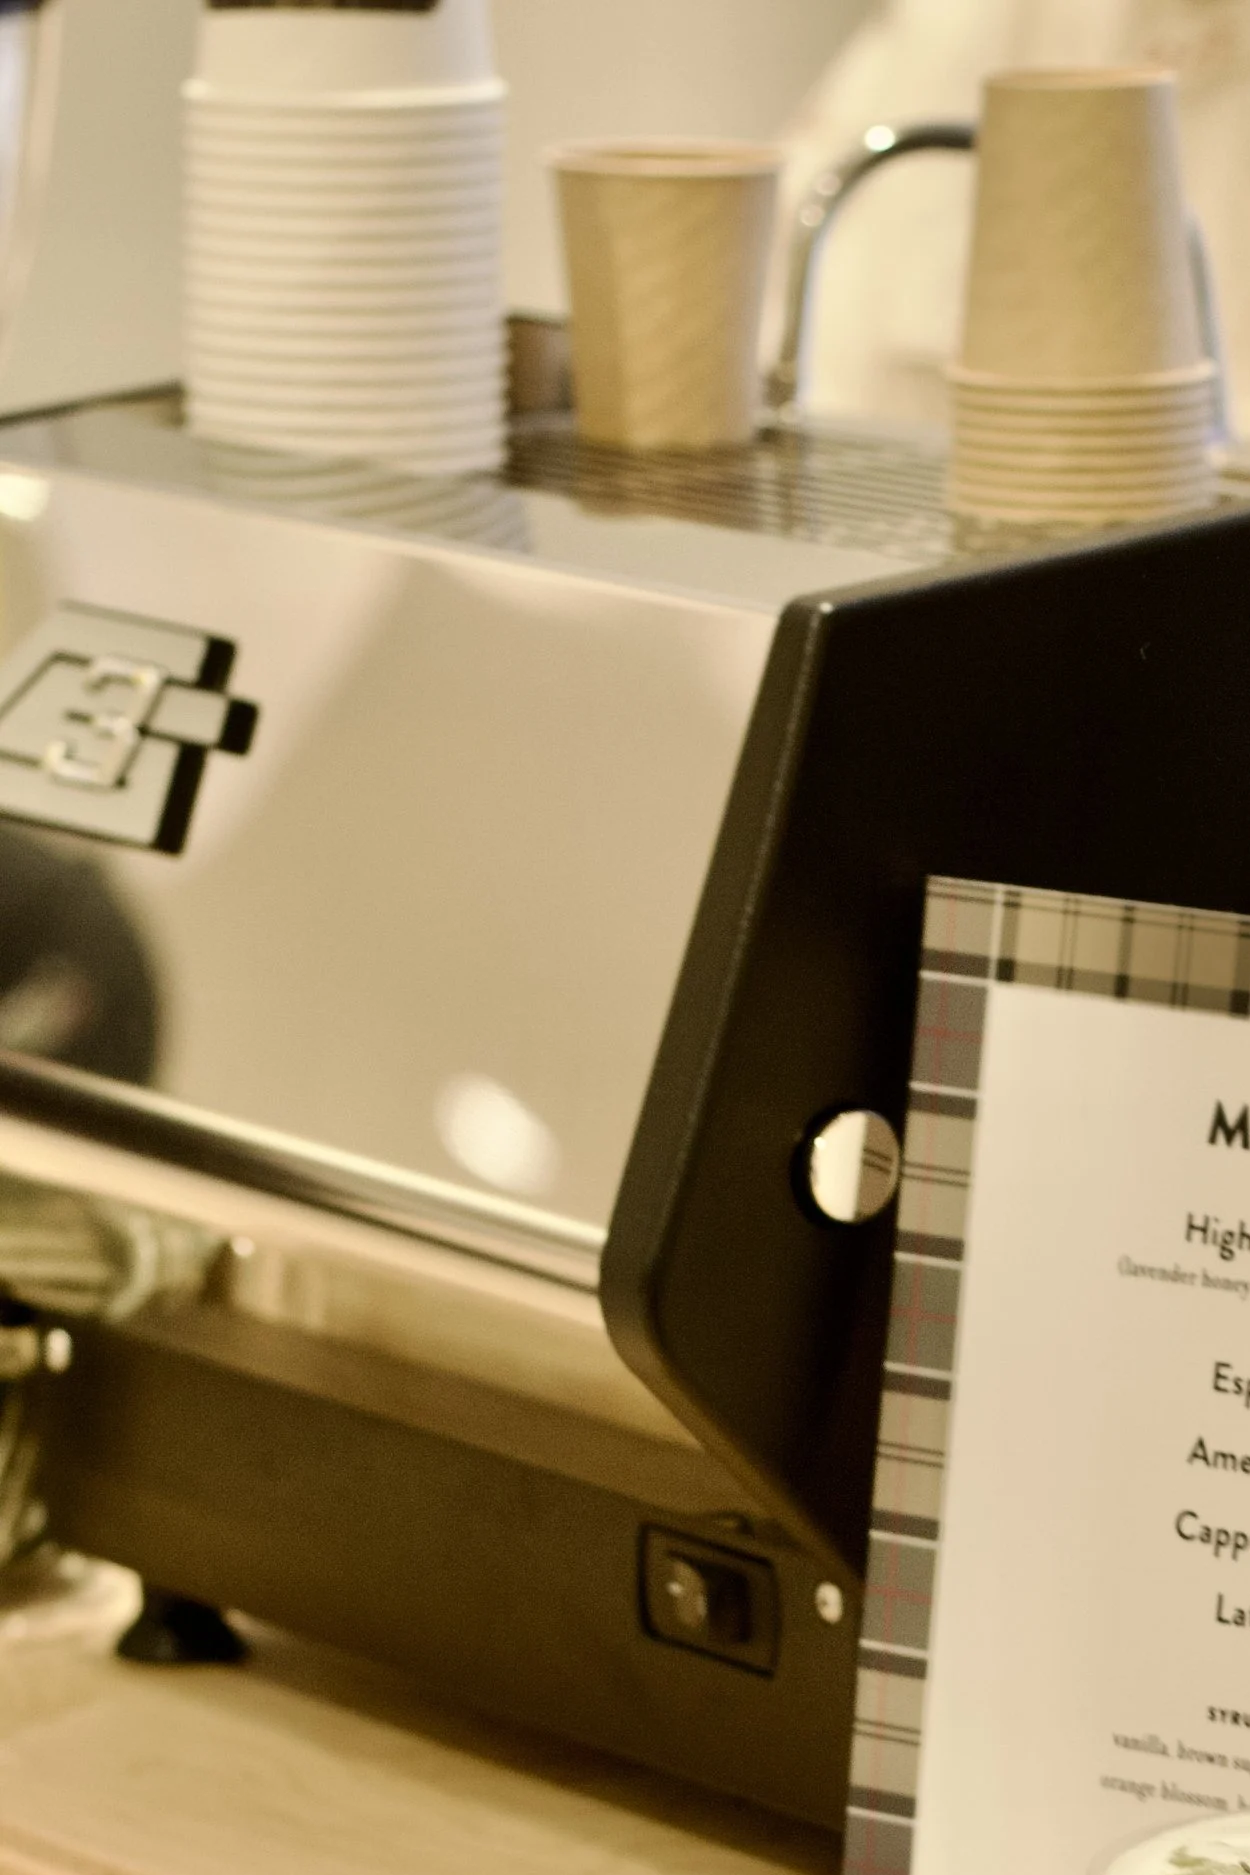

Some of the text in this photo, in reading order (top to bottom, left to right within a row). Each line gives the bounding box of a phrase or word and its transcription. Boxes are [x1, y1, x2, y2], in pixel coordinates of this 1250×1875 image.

[1117, 1255, 1198, 1285] (lavender
[1201, 1269, 1250, 1299] honey
[1177, 1738, 1228, 1767] brown
[1100, 1775, 1155, 1802] orange
